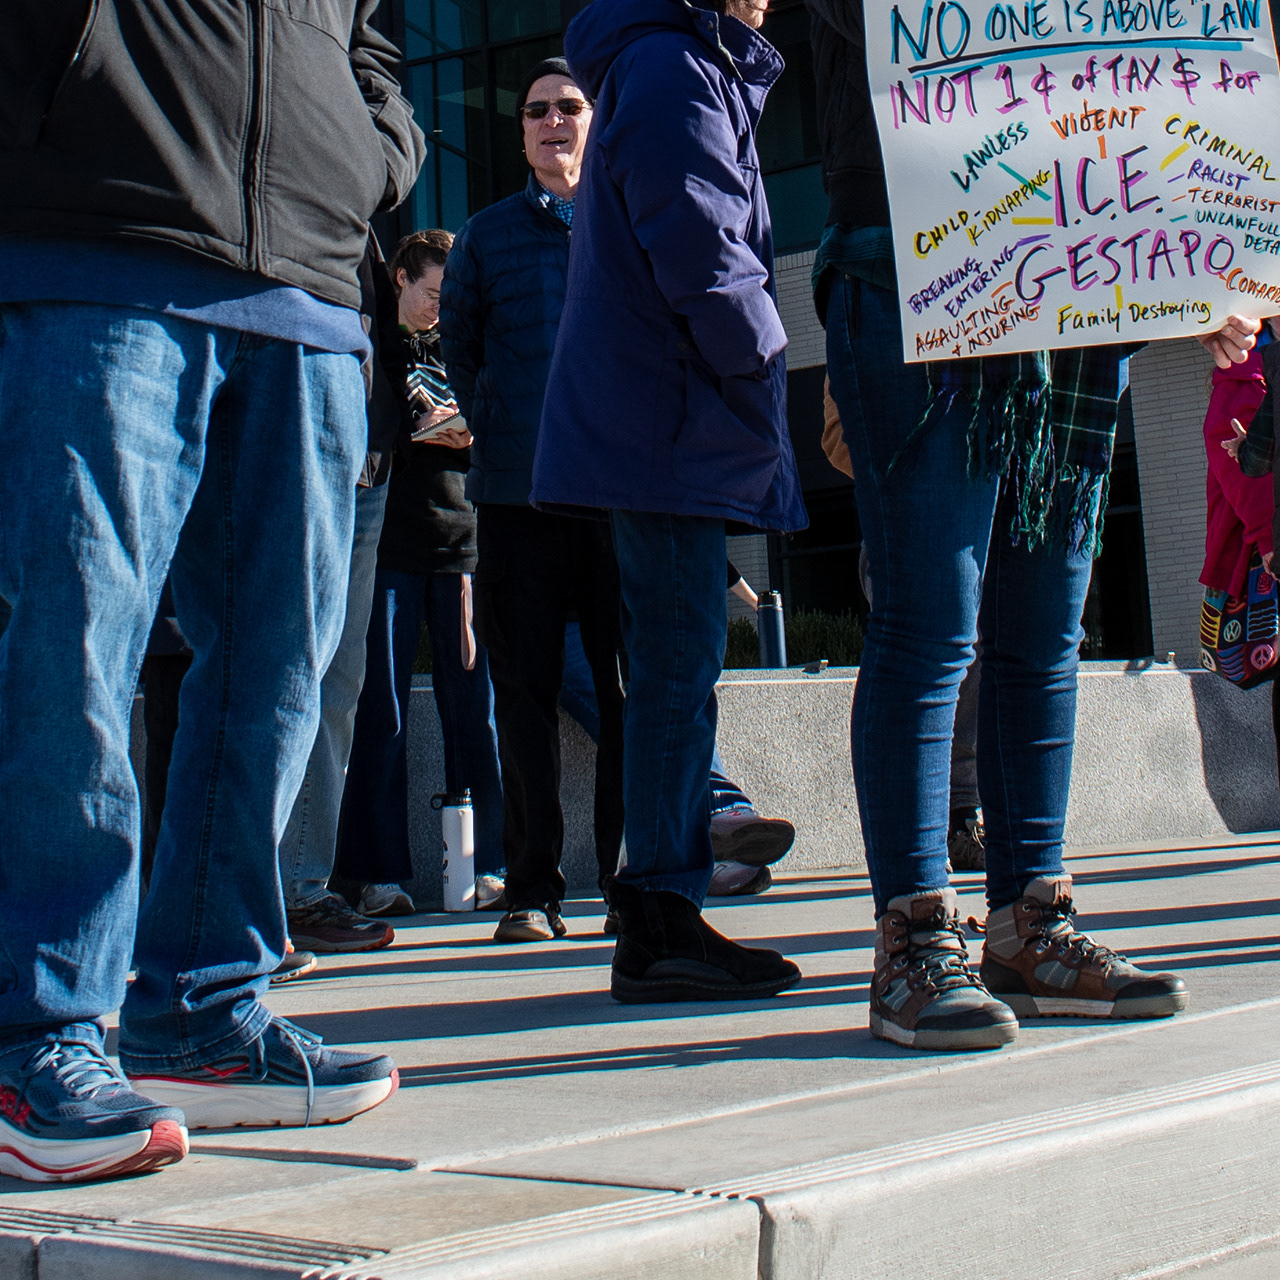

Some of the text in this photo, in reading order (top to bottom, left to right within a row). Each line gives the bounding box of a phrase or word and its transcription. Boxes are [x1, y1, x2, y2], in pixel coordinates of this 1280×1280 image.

[890, 64, 983, 128] NOT
[1071, 55, 1101, 92] of
[1102, 52, 1163, 96] TAX
[1169, 47, 1201, 105] $
[1212, 58, 1261, 94] for
[950, 121, 1029, 193] LAWLESS
[1164, 113, 1278, 181] CRIMINAL
[1188, 158, 1250, 190] RACIST
[967, 169, 1054, 247] KIDNAPPING
[907, 257, 975, 316] BREAKING
[944, 245, 1017, 318] ENTERING
[1015, 229, 1234, 307] GESTAPO
[968, 304, 1041, 355] INJURING
[1057, 298, 1212, 335] Family Destroying
